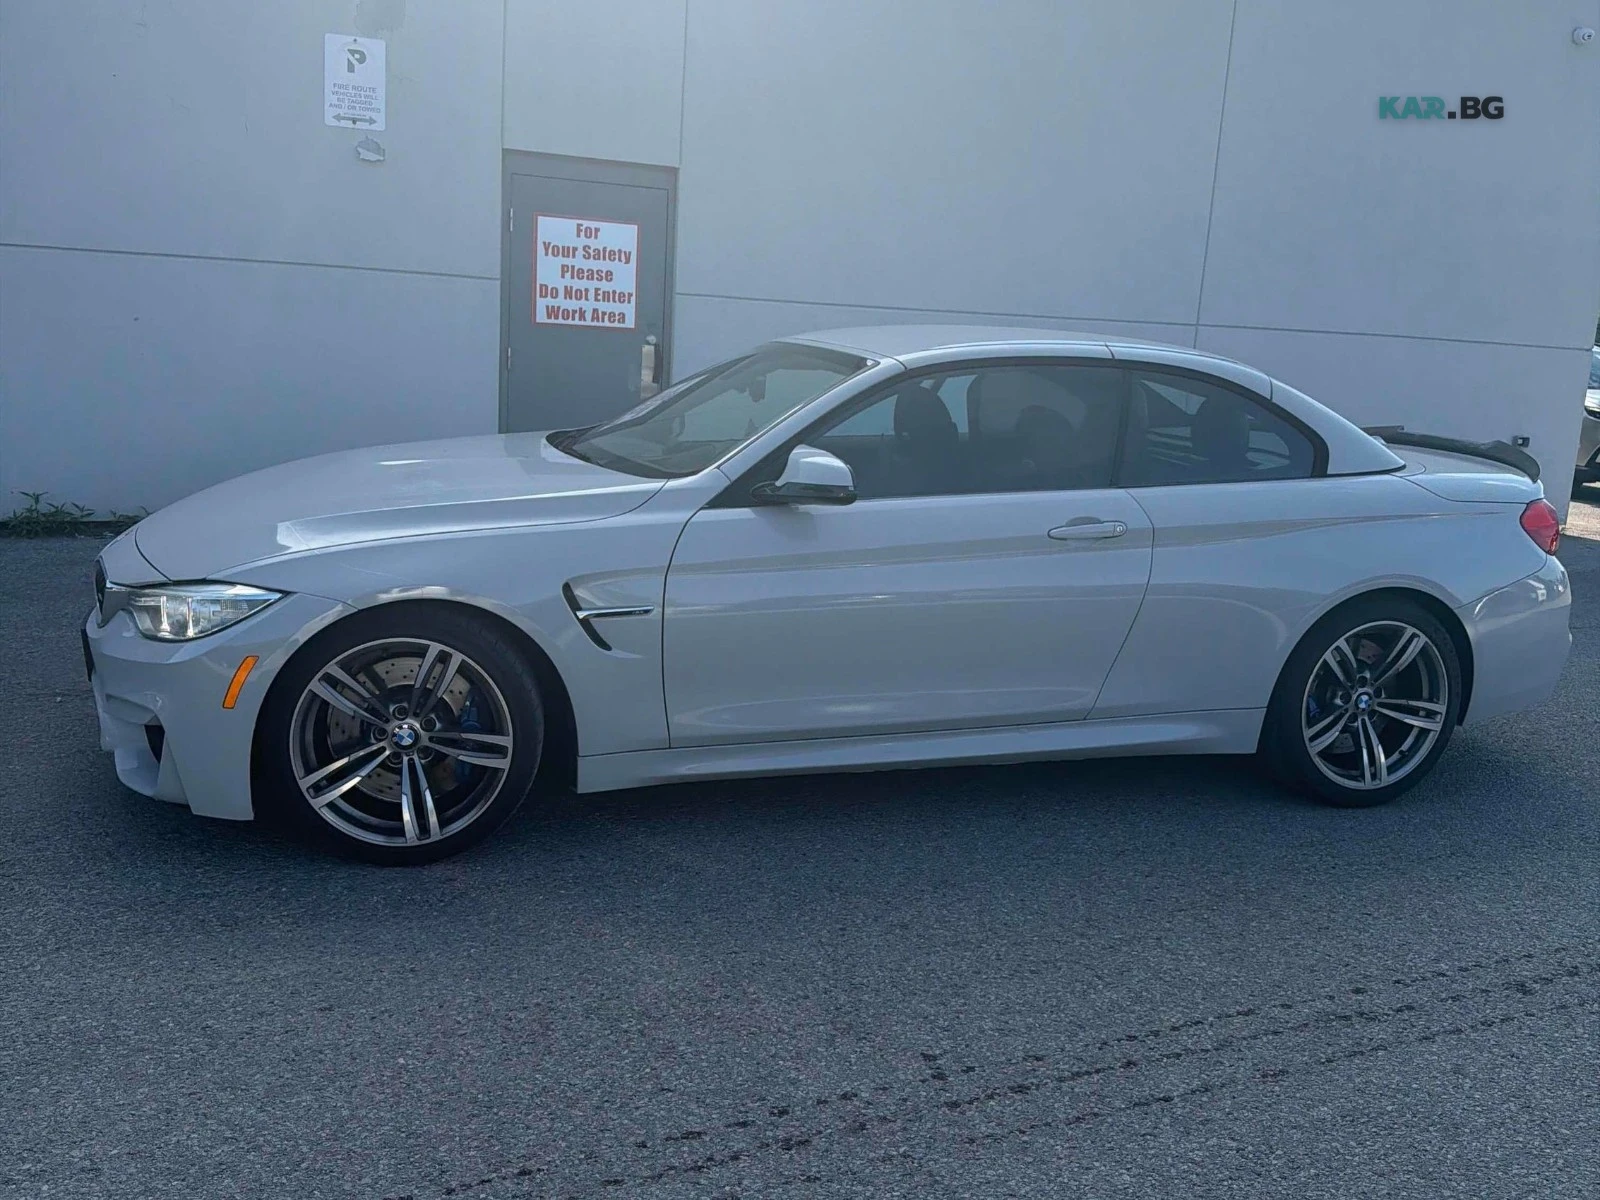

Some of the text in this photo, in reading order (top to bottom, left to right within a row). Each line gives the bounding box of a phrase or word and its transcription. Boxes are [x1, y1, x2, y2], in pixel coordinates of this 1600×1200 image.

[331, 90, 362, 98] VEHICLES
[333, 83, 377, 93] FIRE ROUTE
[347, 98, 373, 106] TAGGED
[576, 223, 601, 240] For
[542, 241, 632, 265] Your Safety
[560, 264, 614, 283] Please
[538, 283, 634, 305] Do Not Enter
[545, 305, 627, 325] Work Area
